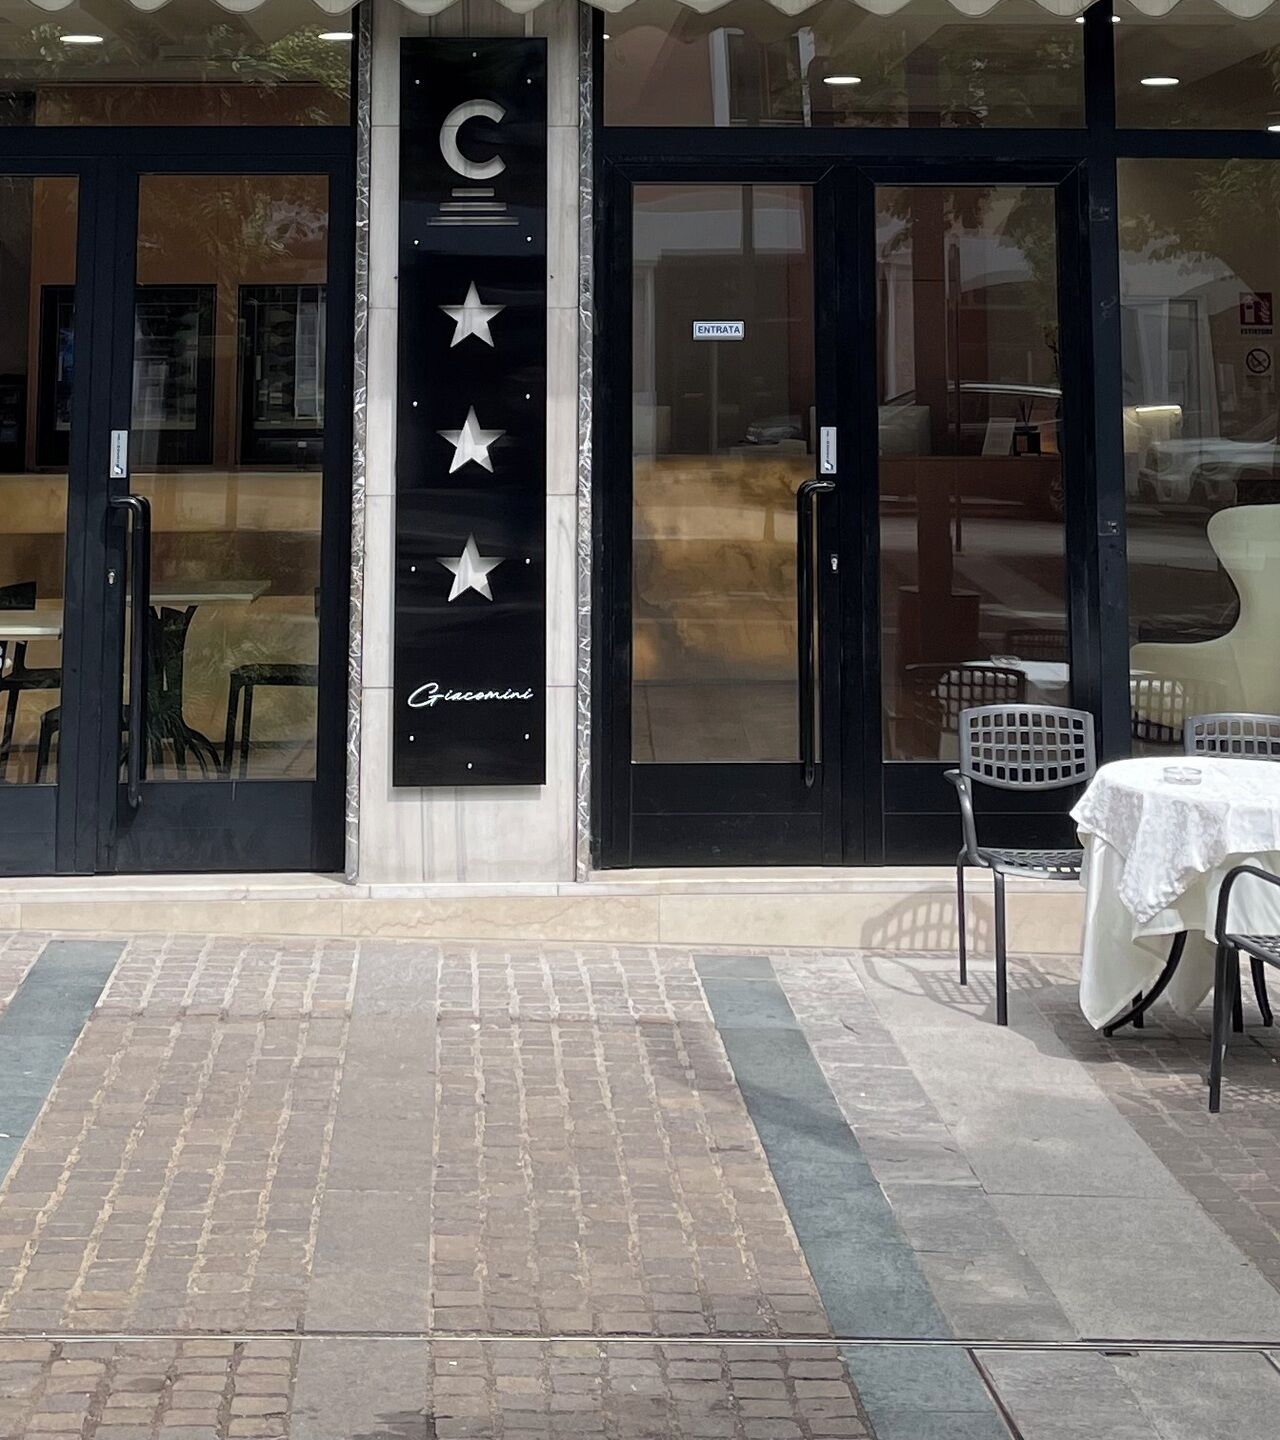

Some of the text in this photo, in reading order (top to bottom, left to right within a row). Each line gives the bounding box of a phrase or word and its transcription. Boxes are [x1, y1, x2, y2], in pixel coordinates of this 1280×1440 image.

[438, 98, 508, 181] C
[697, 325, 741, 334] ENTRATA
[407, 682, 534, 708] Giacomini
